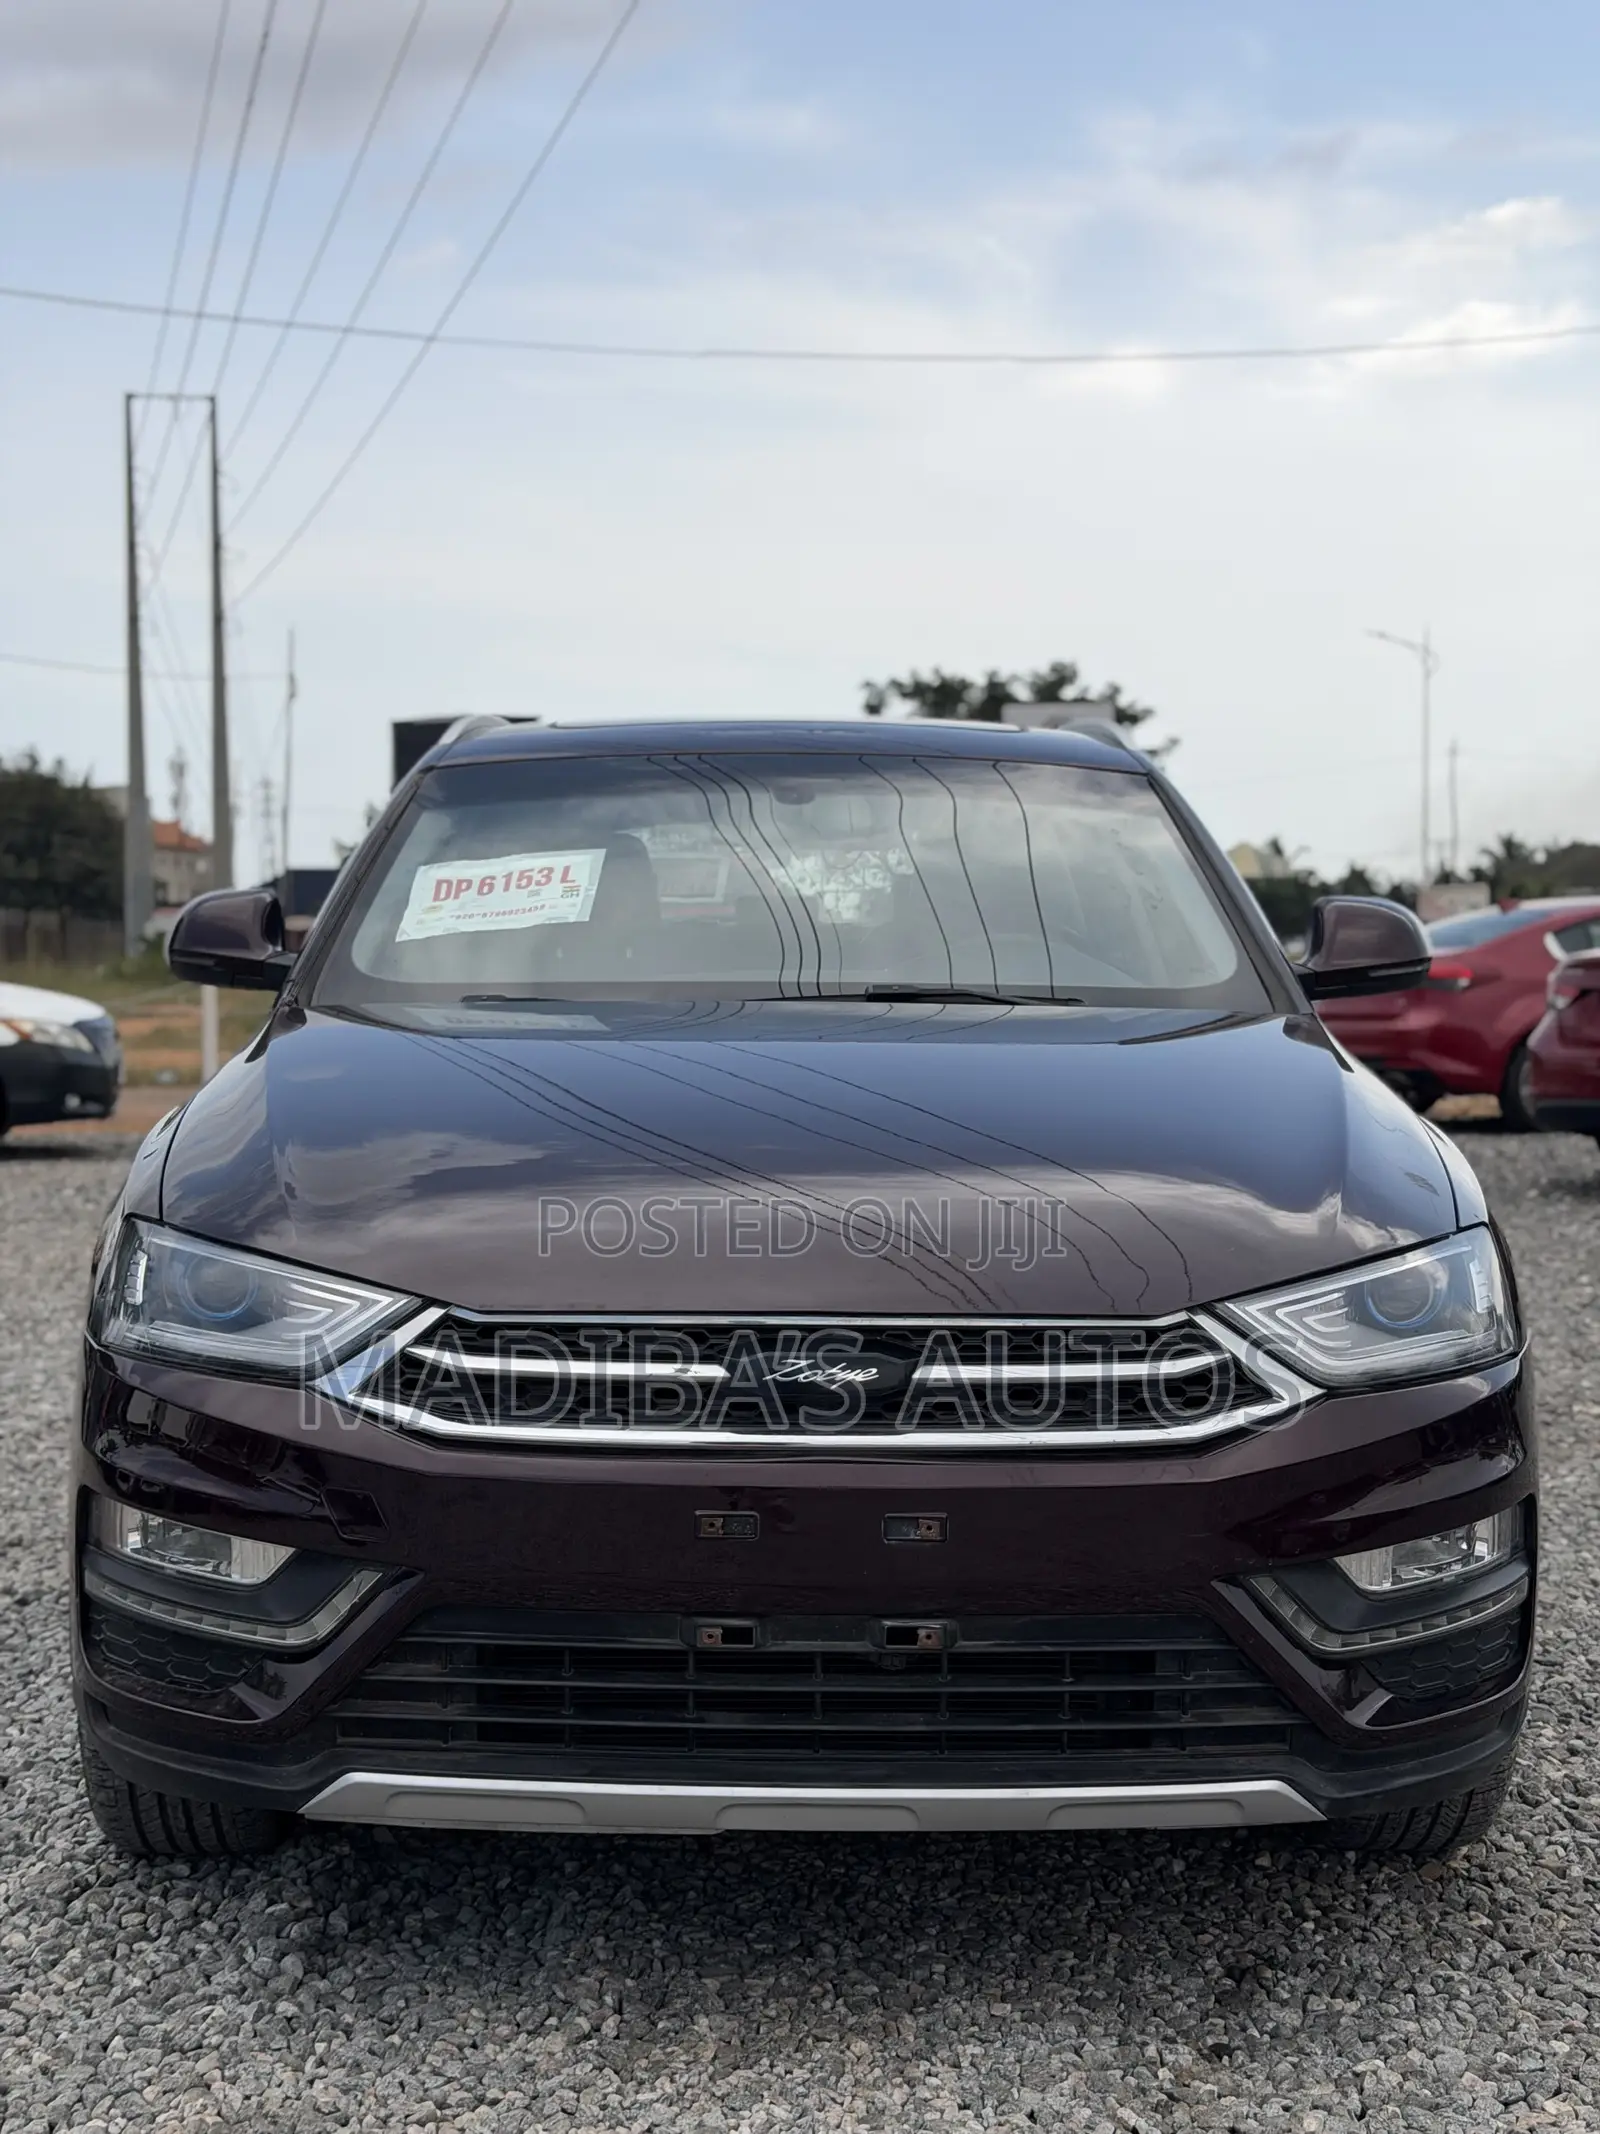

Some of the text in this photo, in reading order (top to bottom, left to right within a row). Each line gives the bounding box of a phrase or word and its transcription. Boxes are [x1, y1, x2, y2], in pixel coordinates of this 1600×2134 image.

[432, 865, 578, 902] DP 6153 L
[762, 1359, 879, 1390] Zotye
